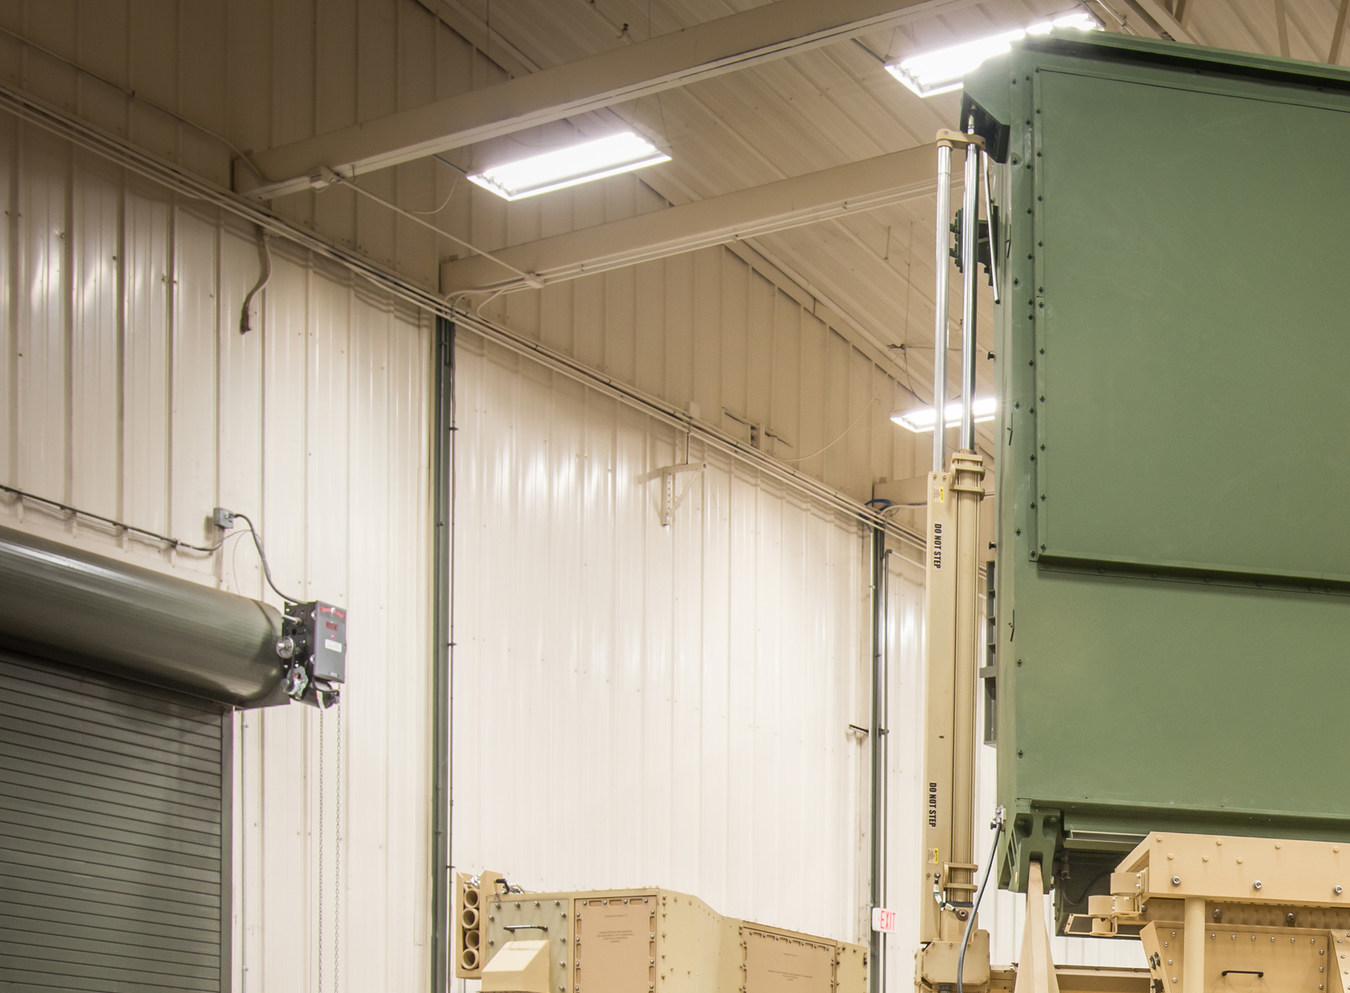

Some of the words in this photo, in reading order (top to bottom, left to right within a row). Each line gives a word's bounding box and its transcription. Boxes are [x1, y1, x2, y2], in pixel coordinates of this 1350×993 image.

[934, 523, 942, 534] DO
[934, 535, 942, 549] NOT
[933, 551, 942, 569] STEP
[929, 782, 937, 793] DO
[929, 794, 937, 808] NOT
[928, 809, 937, 827] STEP
[880, 910, 896, 931] EXIT
